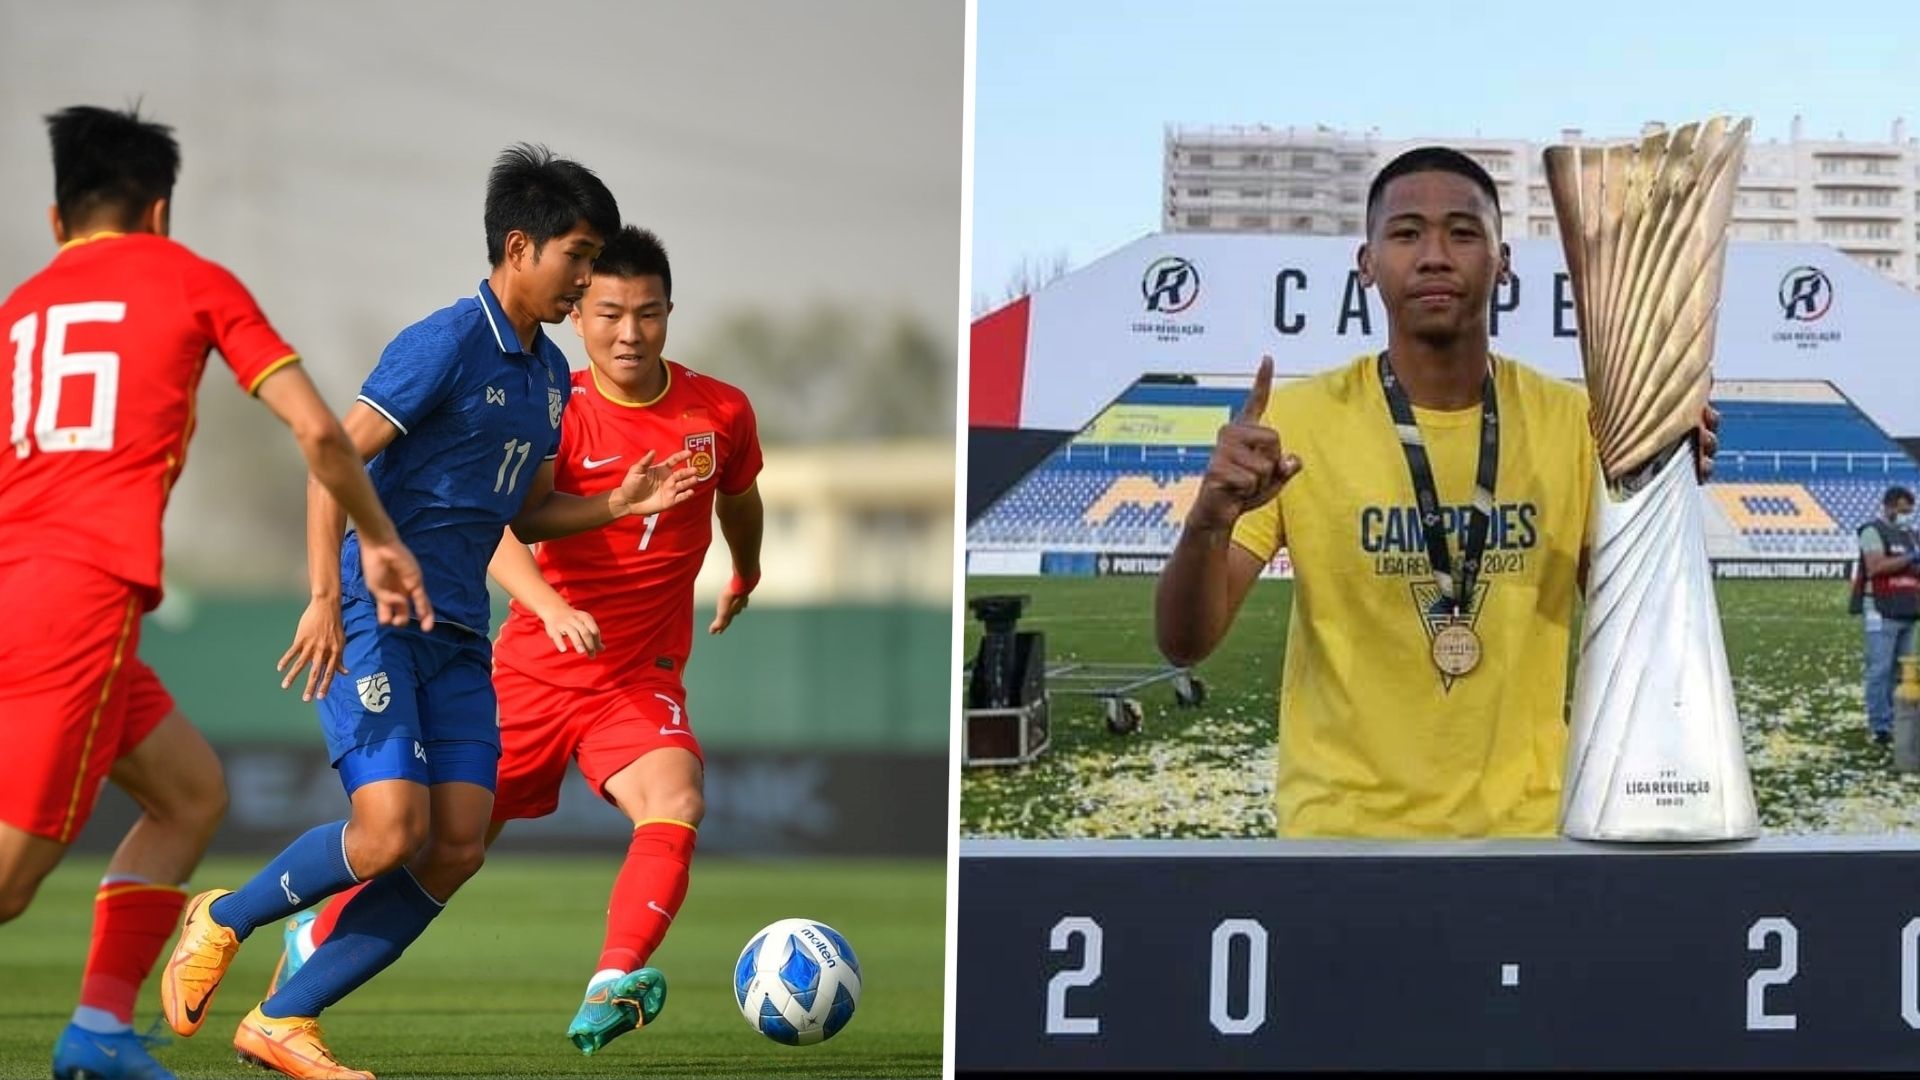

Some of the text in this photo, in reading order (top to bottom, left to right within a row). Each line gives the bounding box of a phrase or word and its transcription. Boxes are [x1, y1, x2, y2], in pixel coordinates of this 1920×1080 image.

[9, 301, 127, 460] 16
[688, 437, 711, 448] CFA
[493, 438, 531, 495] 11
[1484, 553, 1525, 574] 20/21
[801, 928, 836, 969] molten
